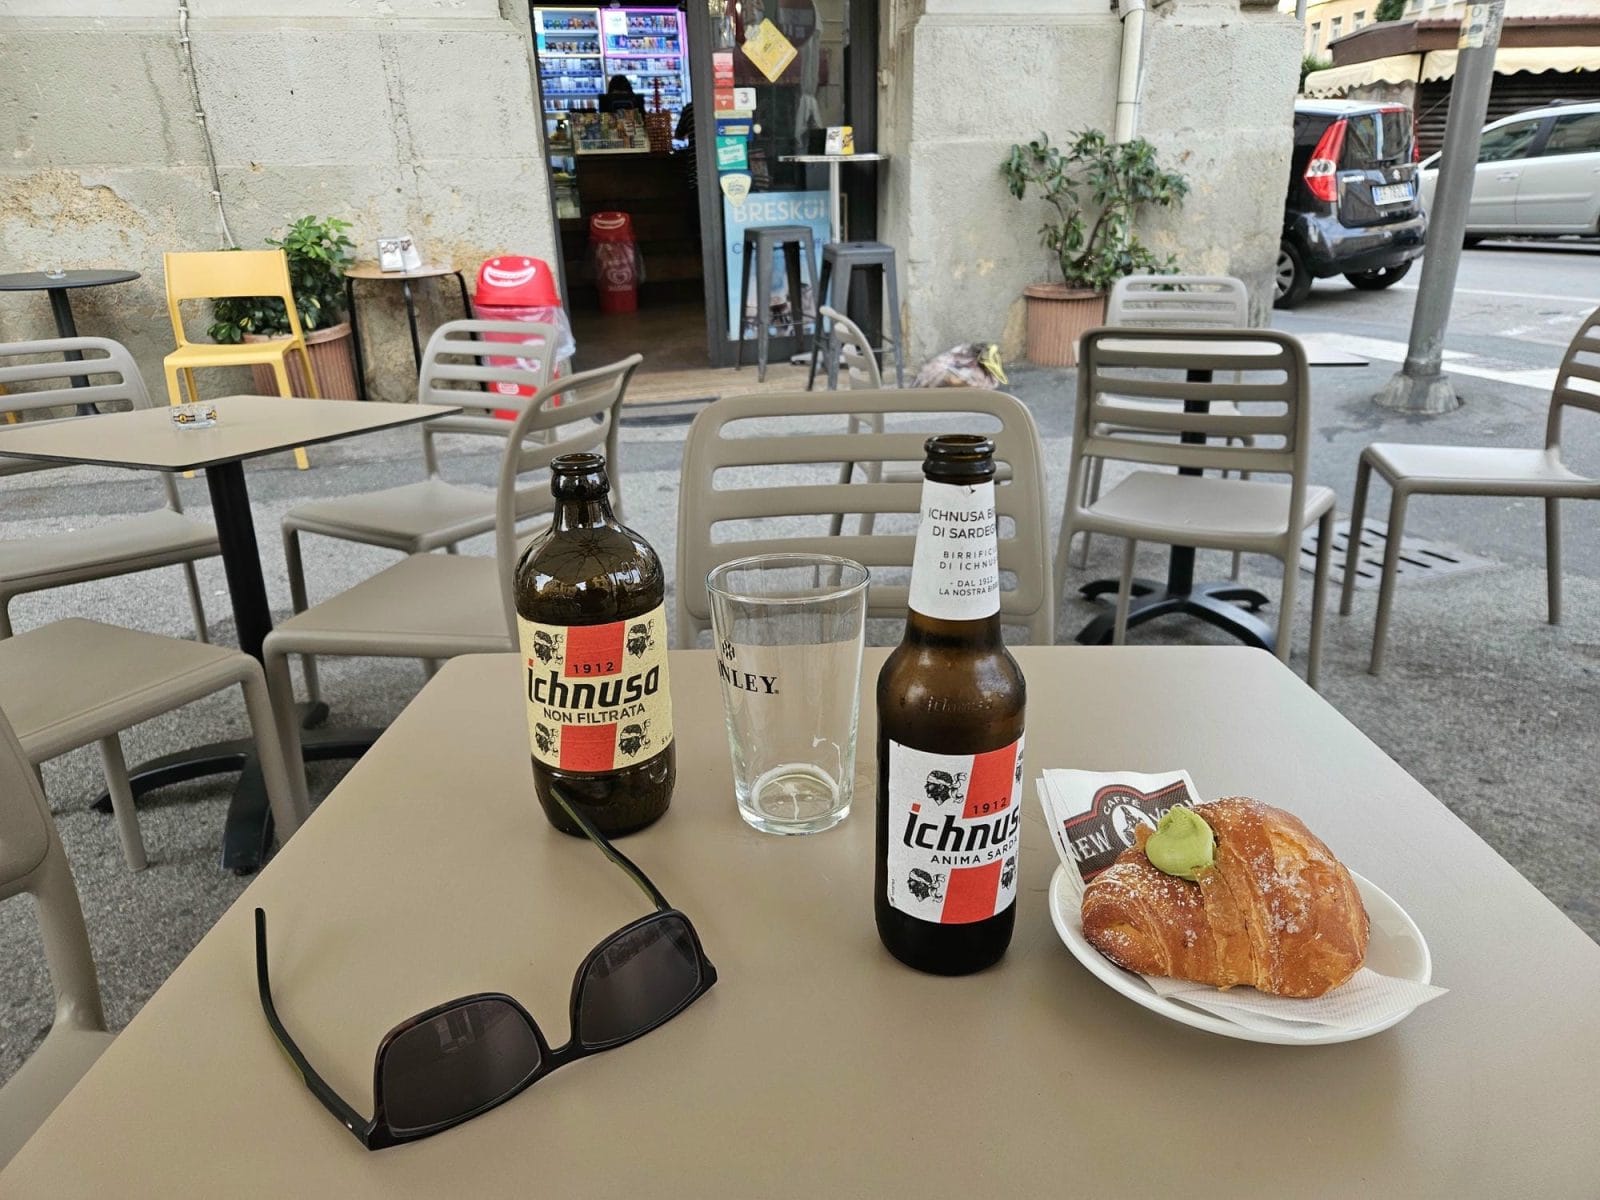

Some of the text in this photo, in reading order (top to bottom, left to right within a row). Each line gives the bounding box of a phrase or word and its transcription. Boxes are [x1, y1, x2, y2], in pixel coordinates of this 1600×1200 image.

[928, 507, 985, 522] ICHNUSA
[932, 525, 945, 538] DI
[939, 561, 953, 570] DI
[957, 580, 976, 588] DAL
[939, 588, 950, 596] LA
[952, 587, 986, 597] NOSTRA
[573, 661, 614, 674] 1912
[527, 657, 660, 710] ichnusa
[543, 702, 646, 724] NON FILTRATA
[973, 797, 1008, 815] 1912
[903, 803, 1021, 852] ichnus
[931, 854, 981, 865] ANIMA
